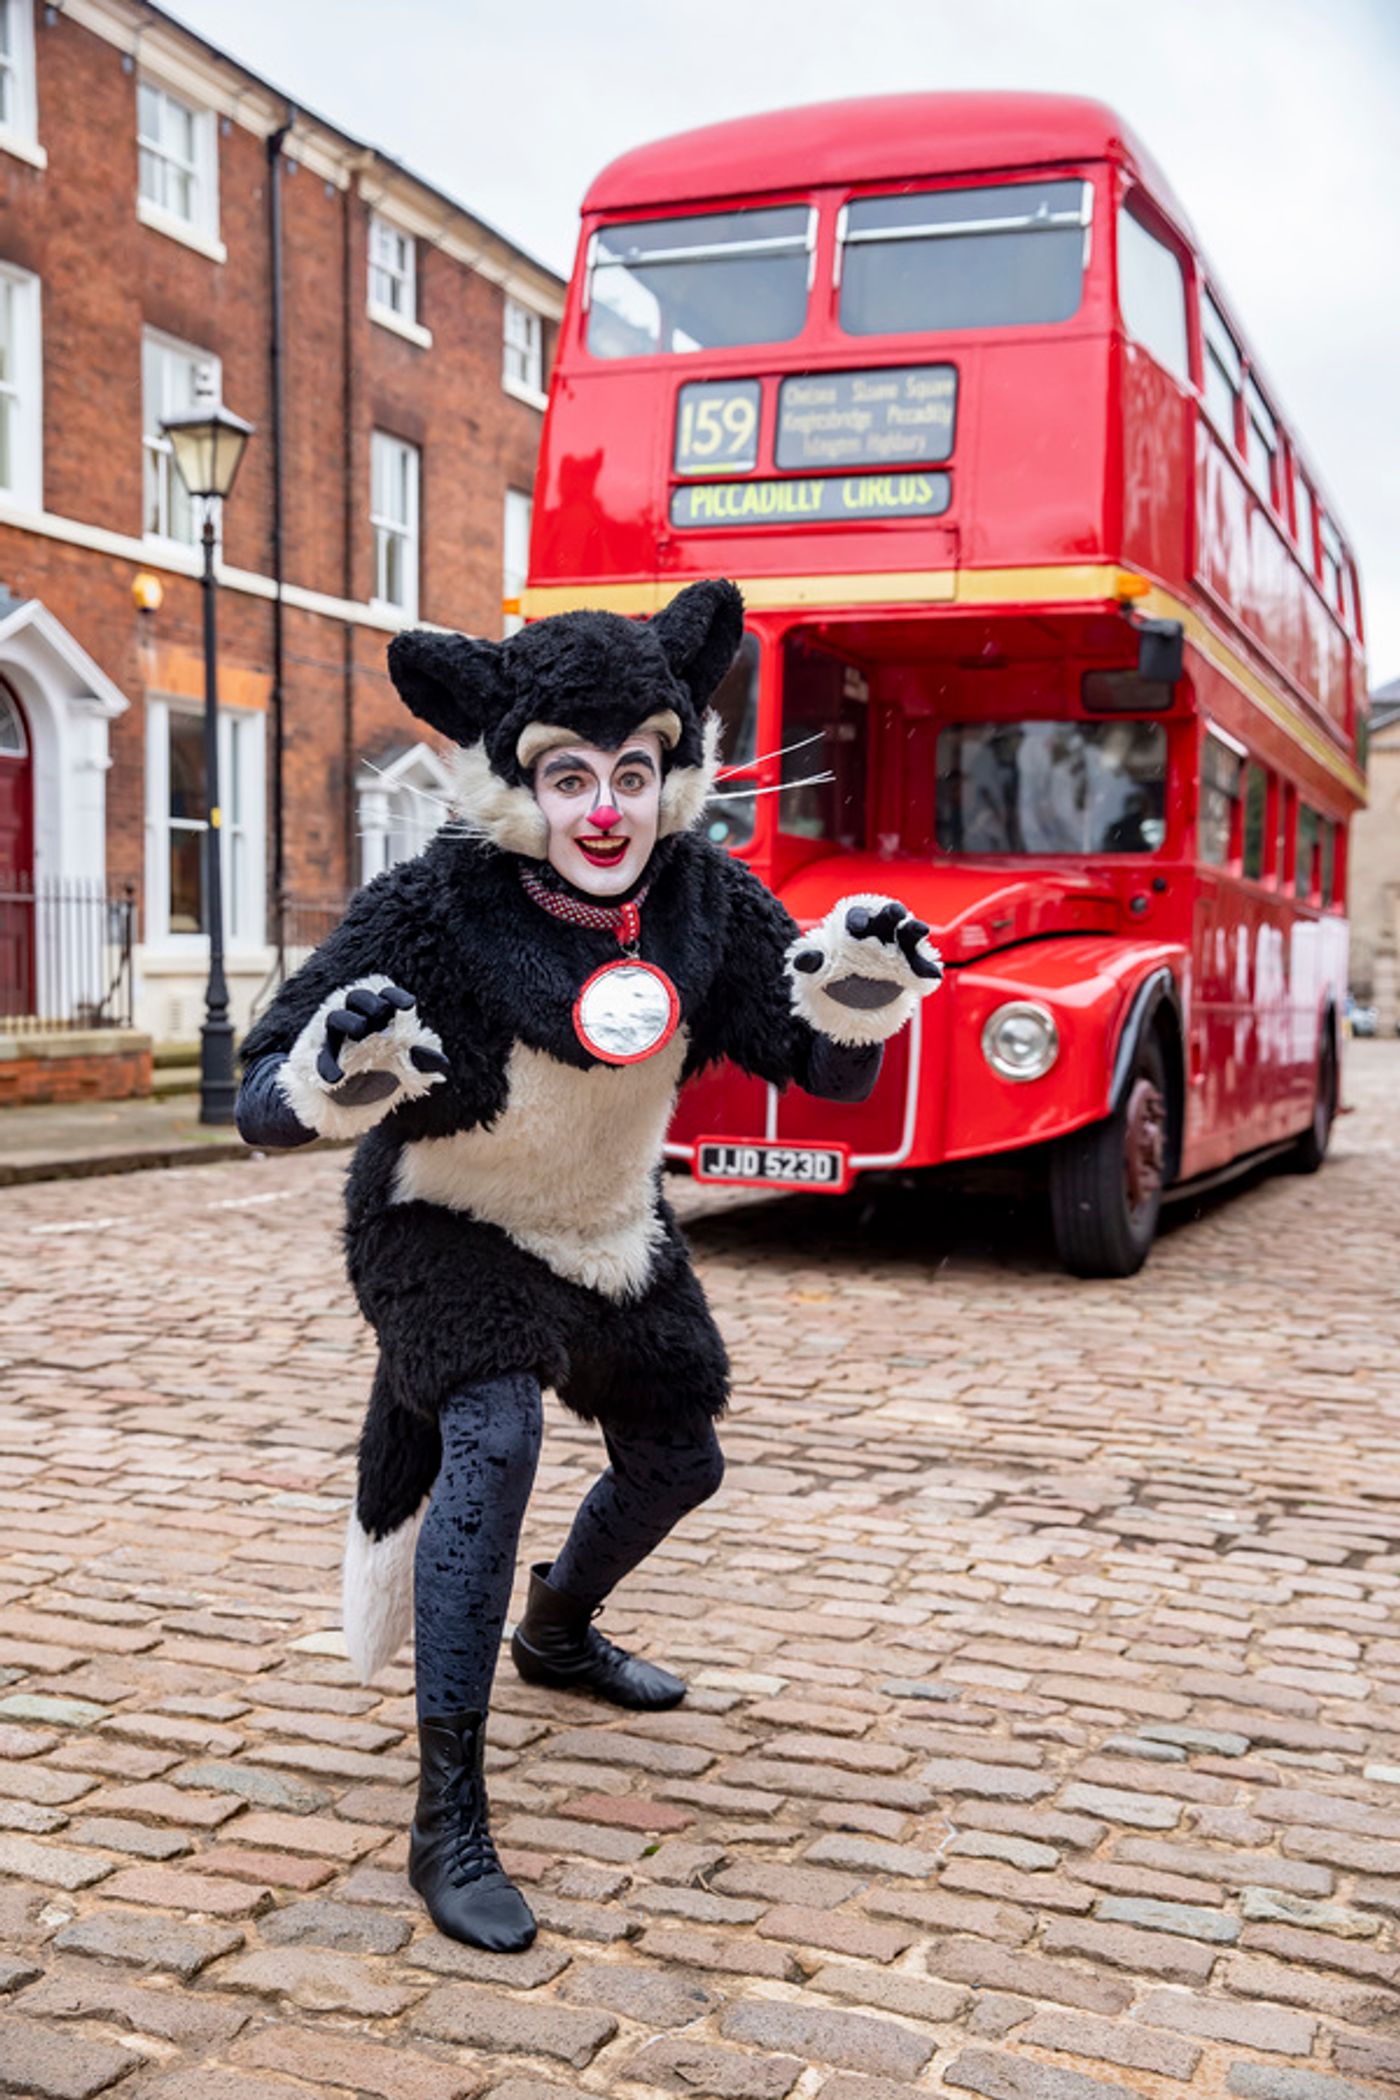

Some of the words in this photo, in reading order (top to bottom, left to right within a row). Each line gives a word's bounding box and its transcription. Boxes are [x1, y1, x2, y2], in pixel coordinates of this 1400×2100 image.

[680, 396, 756, 457] 159
[691, 479, 824, 518] PICCADILLY
[843, 474, 933, 508] CIRCUS
[708, 1148, 759, 1177] JJD
[765, 1150, 832, 1181] 523D
